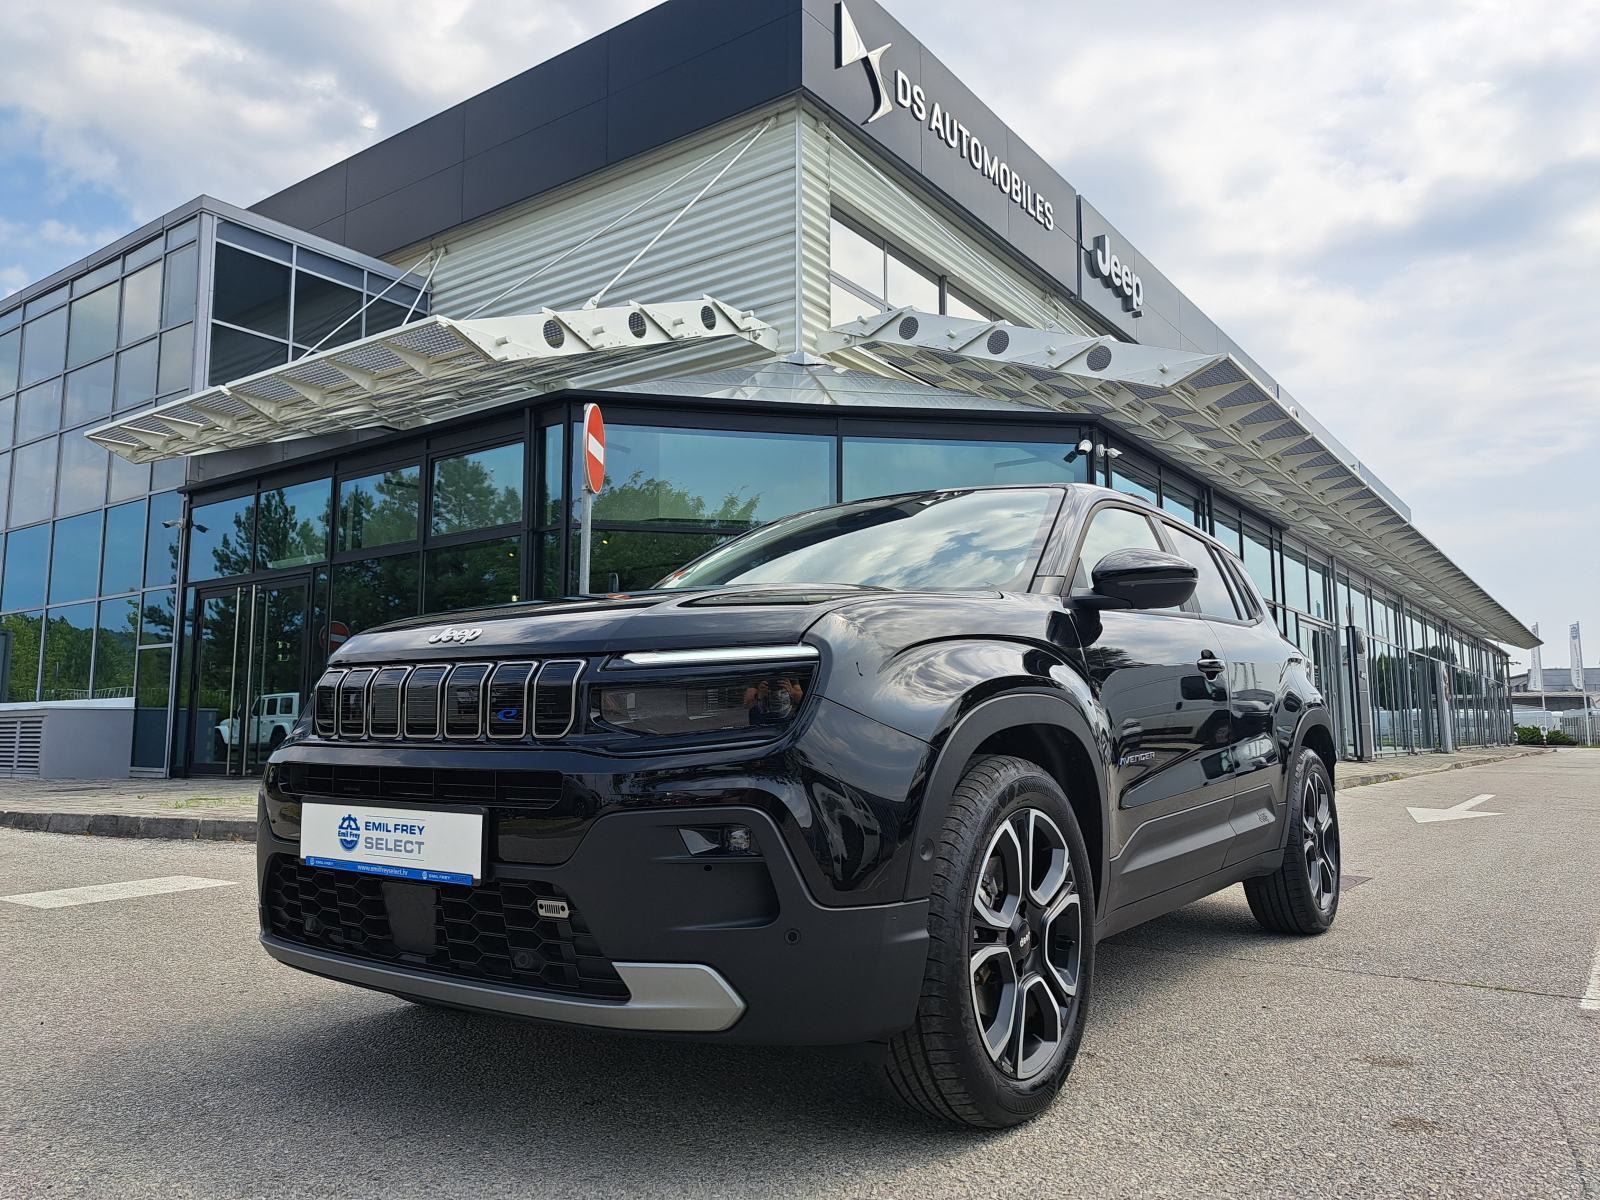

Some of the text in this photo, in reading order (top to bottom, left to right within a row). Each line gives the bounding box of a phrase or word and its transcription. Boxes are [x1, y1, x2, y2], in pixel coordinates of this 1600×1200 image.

[895, 69, 1054, 231] DS AUTOMOBILES
[1088, 234, 1144, 312] Jeep
[428, 627, 483, 644] Jeep
[1119, 751, 1155, 766] AVENGER
[337, 830, 361, 840] Emil Frey
[364, 821, 425, 836] EMIL FREY
[364, 836, 425, 855] SELECT
